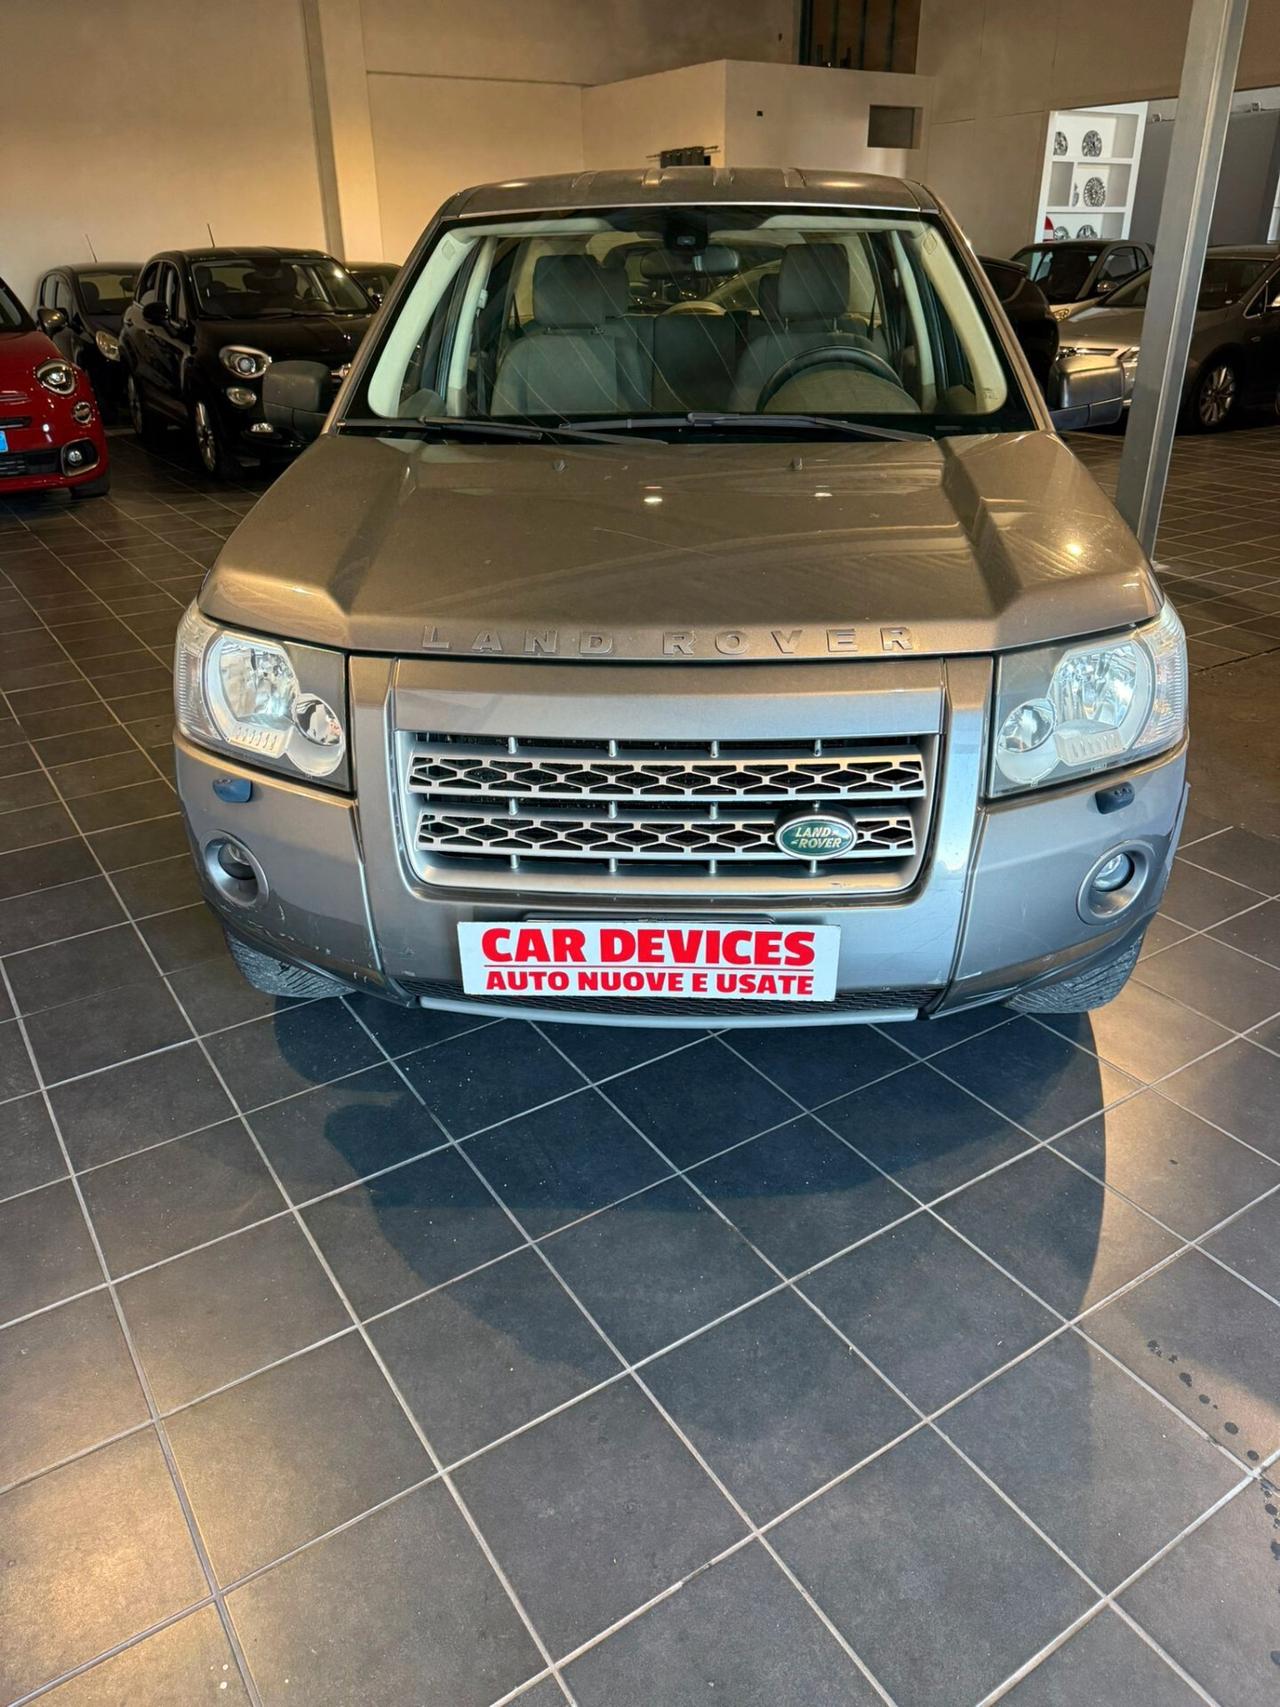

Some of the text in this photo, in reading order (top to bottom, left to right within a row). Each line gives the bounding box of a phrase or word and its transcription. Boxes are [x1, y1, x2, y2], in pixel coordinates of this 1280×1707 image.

[421, 624, 915, 657] LAND ROVER
[795, 826, 832, 838] LAND
[798, 837, 842, 849] ROVER
[481, 927, 816, 967] CAR DEVICES
[486, 970, 814, 995] AUTO NUOVE E USATE
